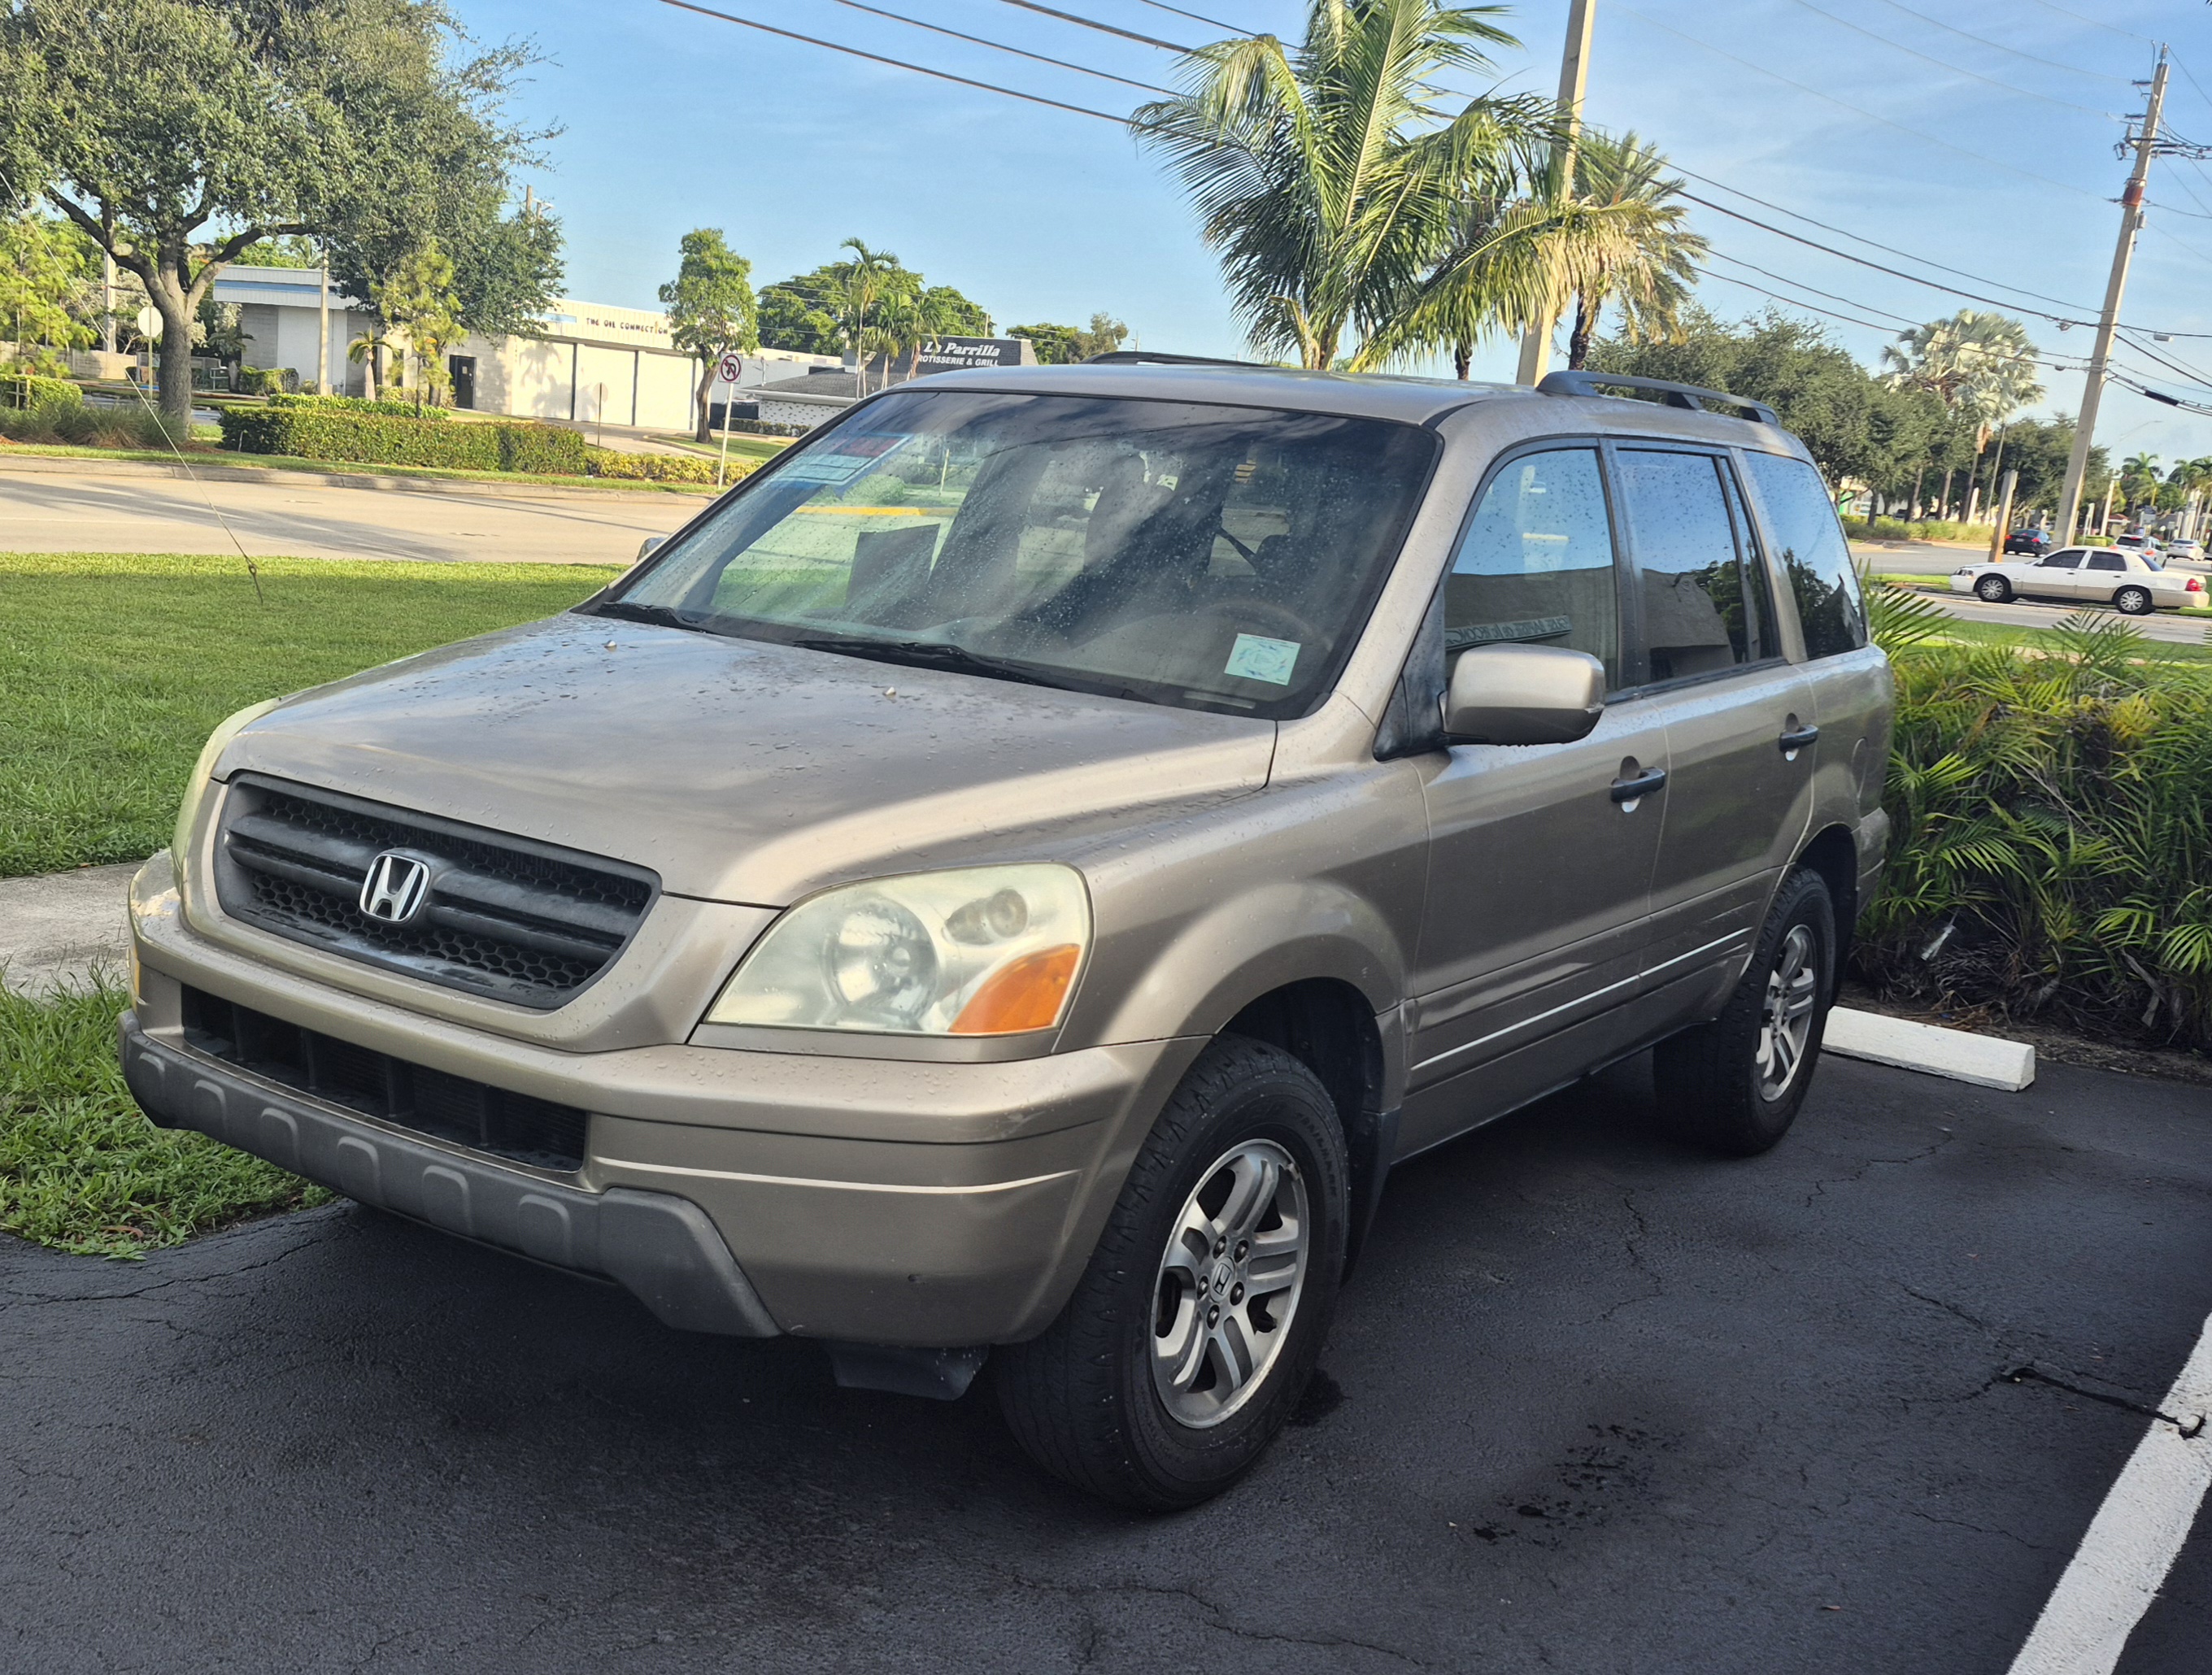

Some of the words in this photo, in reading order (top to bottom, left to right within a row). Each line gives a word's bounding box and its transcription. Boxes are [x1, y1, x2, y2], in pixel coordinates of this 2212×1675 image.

[586, 318, 599, 326] THE
[603, 320, 616, 328] OIL
[620, 321, 668, 334] CONNECTION
[943, 342, 1001, 357] Parrilla
[918, 355, 965, 365] ROTISSERIE
[966, 358, 973, 366] &
[975, 359, 999, 368] GRILL
